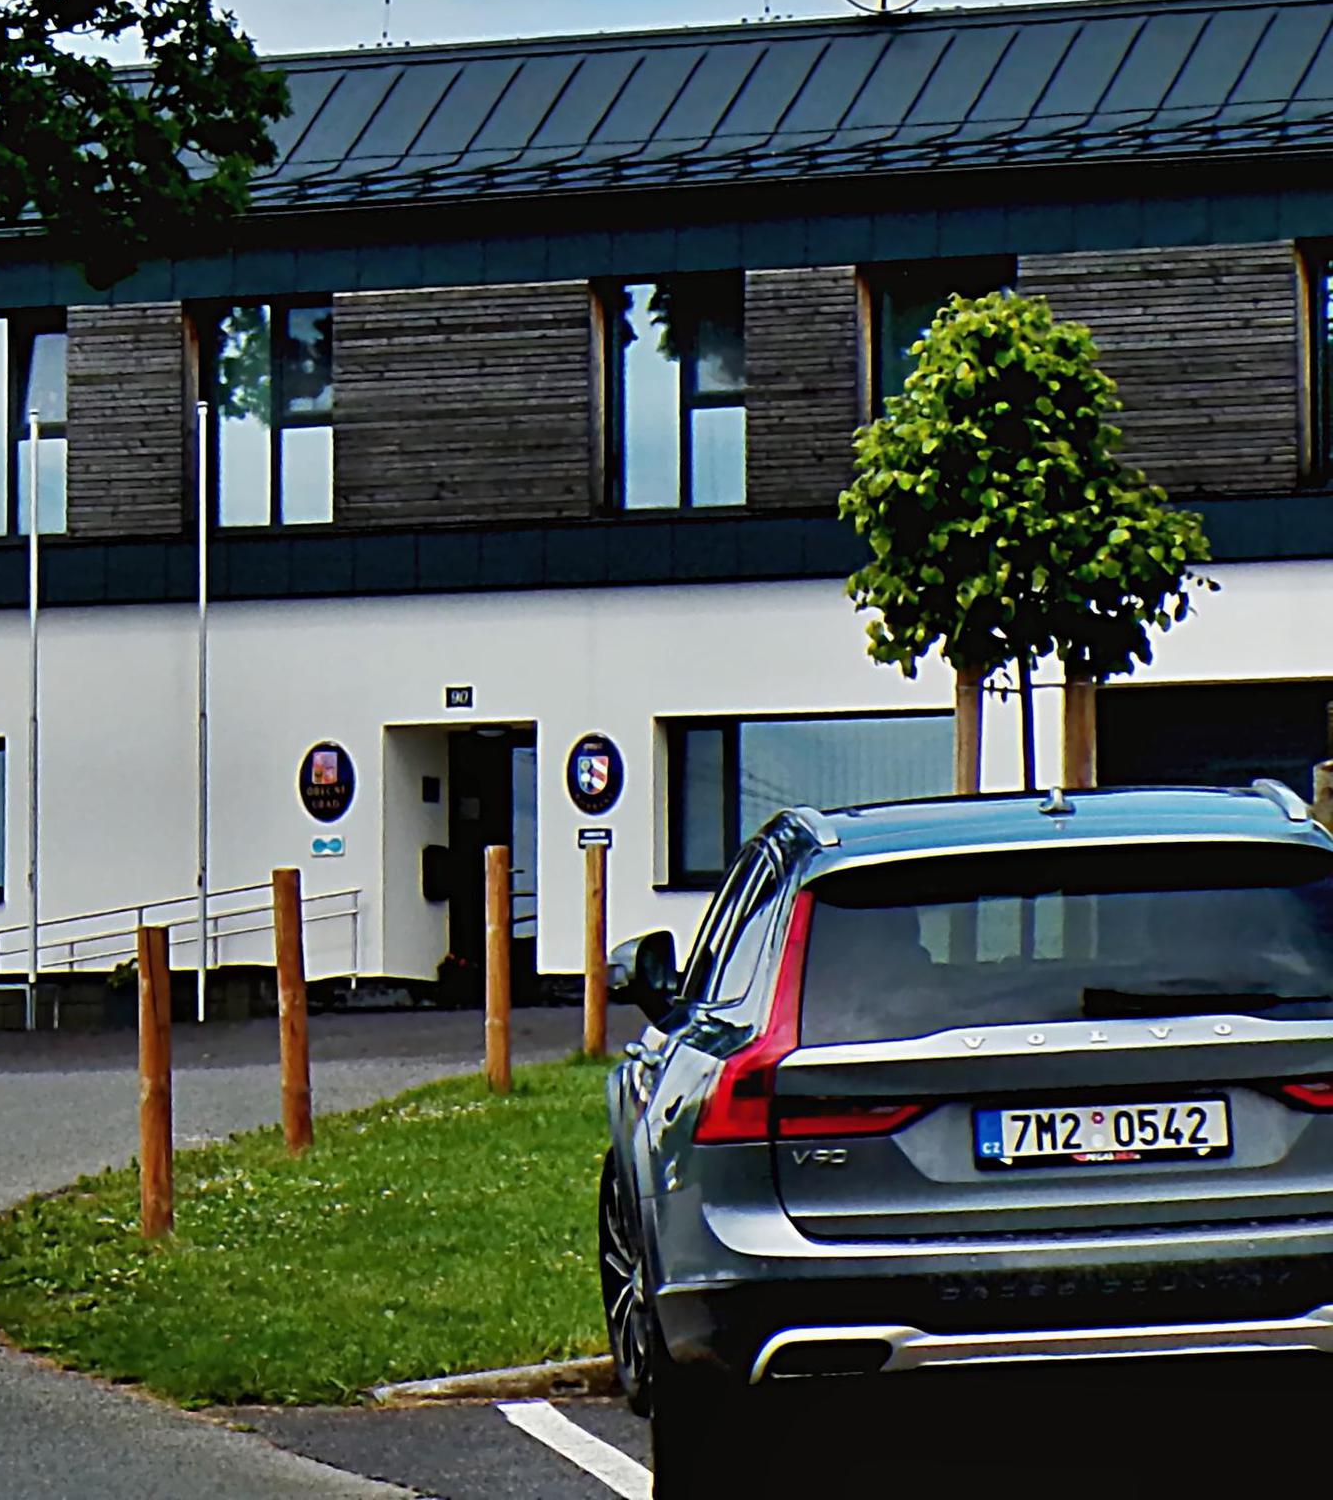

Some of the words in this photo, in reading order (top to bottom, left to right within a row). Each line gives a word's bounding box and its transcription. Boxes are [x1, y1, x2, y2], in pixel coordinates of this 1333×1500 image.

[962, 1022, 1233, 1050] VOLVO
[982, 1141, 1001, 1155] CZ
[1009, 1111, 1083, 1153] 7M2
[1113, 1106, 1209, 1148] 0542
